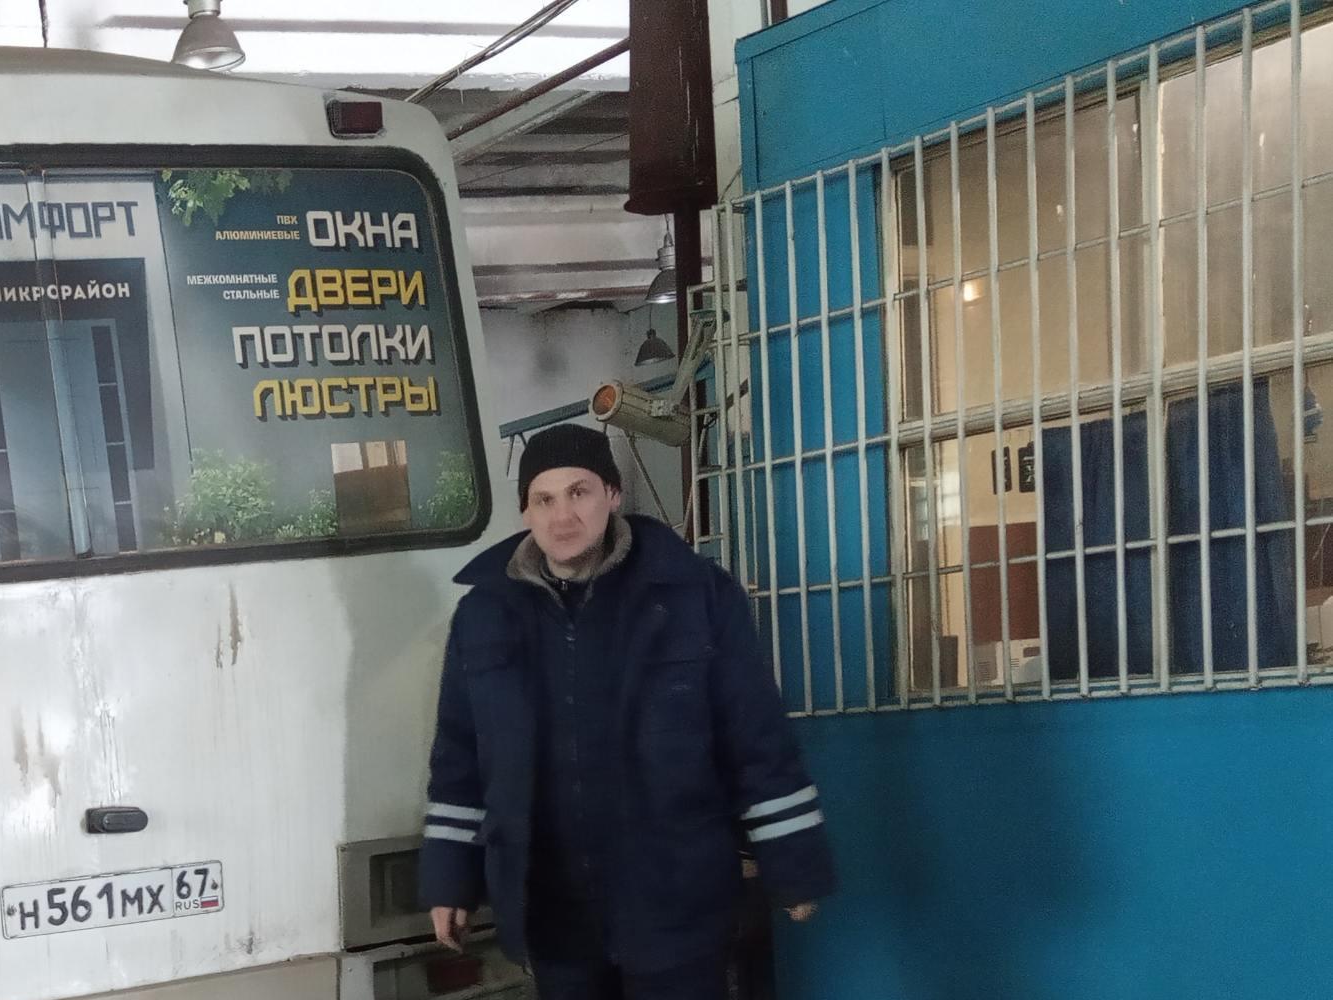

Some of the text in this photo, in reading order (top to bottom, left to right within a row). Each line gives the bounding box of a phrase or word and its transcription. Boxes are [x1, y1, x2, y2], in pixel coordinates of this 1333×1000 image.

[277, 215, 298, 225] ПВХ
[306, 210, 419, 248] ОКНА
[215, 230, 300, 241] АЛЮМИНИЕВЫЕ
[187, 274, 278, 285] МЕЖКОМНАТНЫЕ
[223, 289, 279, 300] СТАЛЬНЫЕ
[287, 269, 426, 313] ДВЕРИ
[232, 324, 432, 364] ПОТОЛКИ
[253, 376, 438, 417] ЛЮСТРЫ
[175, 868, 210, 899] 67
[175, 899, 200, 911] RUS
